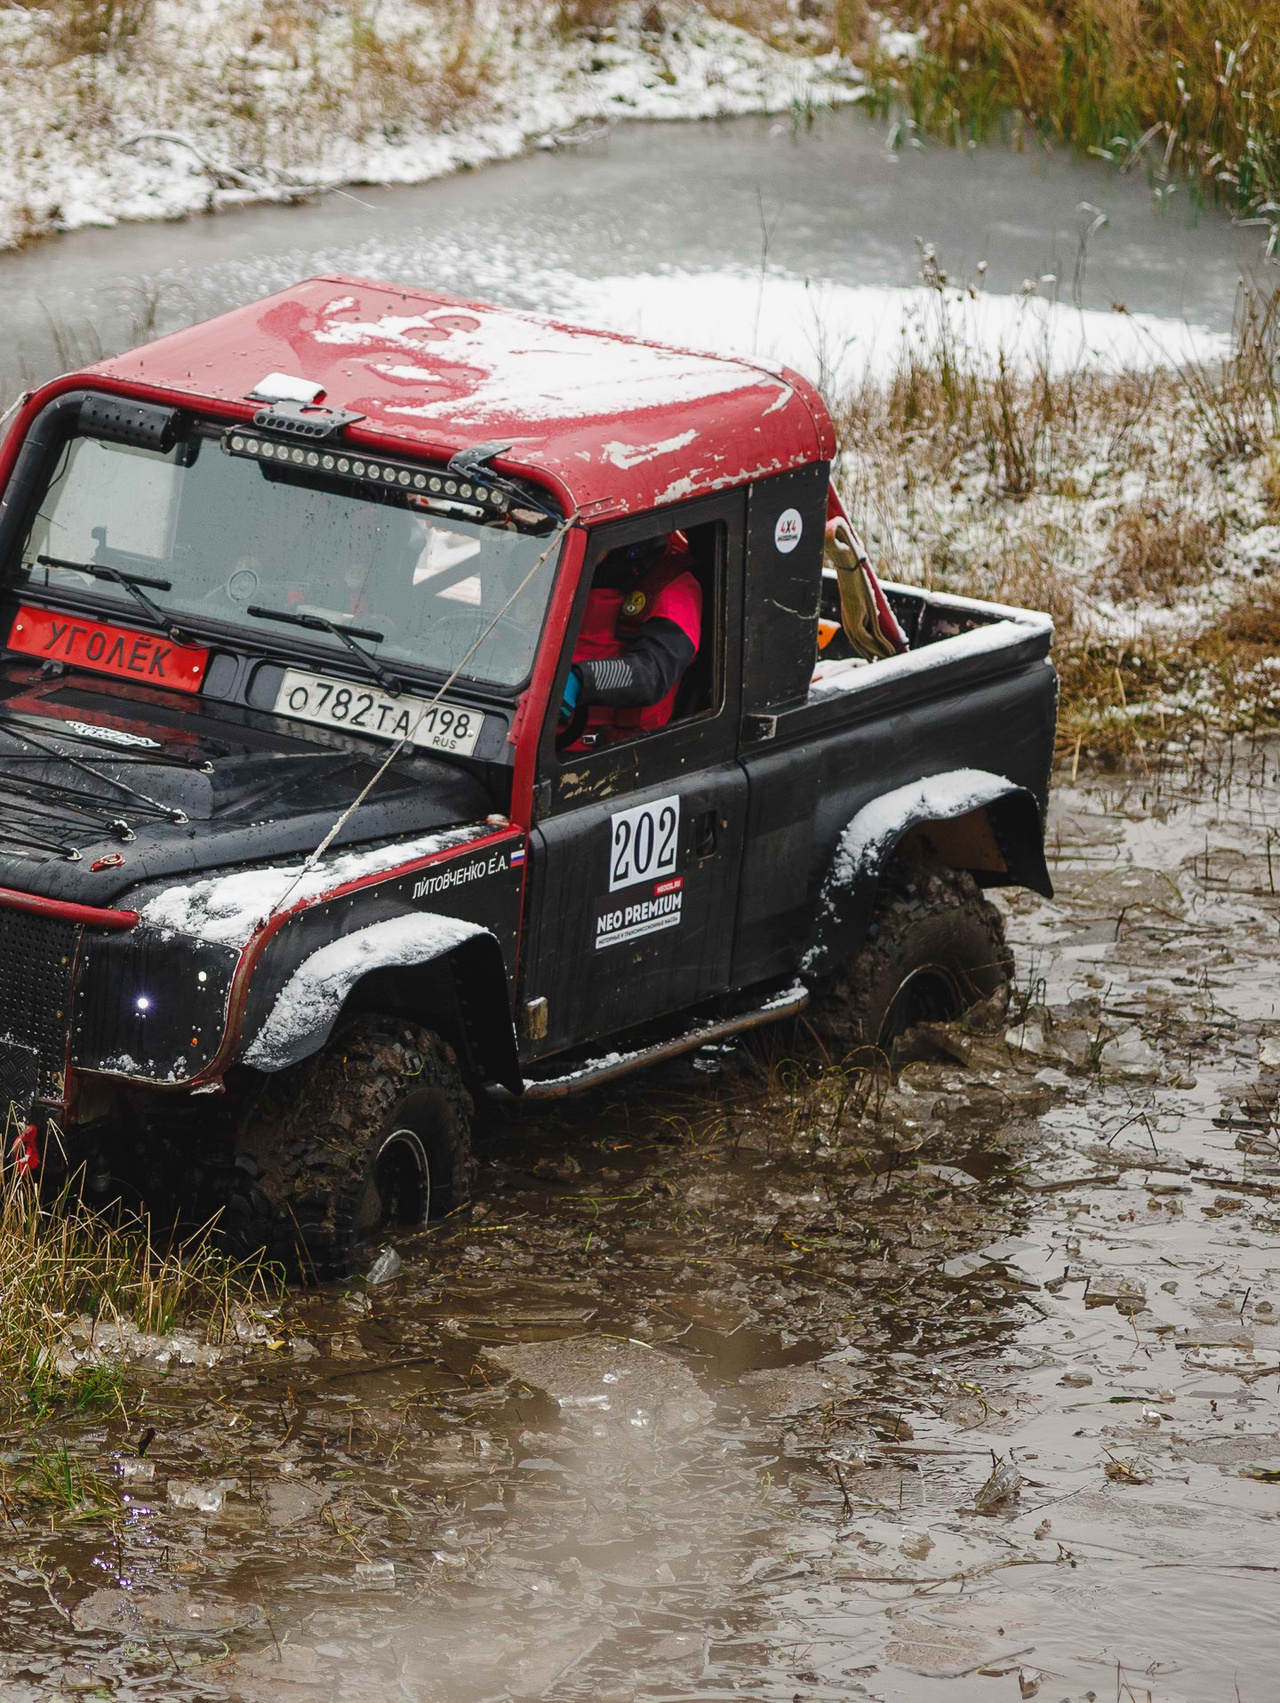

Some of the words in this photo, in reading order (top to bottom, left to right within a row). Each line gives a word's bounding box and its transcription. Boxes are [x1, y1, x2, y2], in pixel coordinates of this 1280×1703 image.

[43, 621, 172, 677] УГОЛЁК
[425, 706, 471, 740] 198
[431, 735, 458, 751] RUS
[613, 806, 677, 884] 202
[411, 861, 486, 900] ЛИТОВЧЕНКО
[487, 855, 509, 875] Е.А.
[596, 909, 623, 935] NEO
[624, 891, 683, 926] PREMIUM
